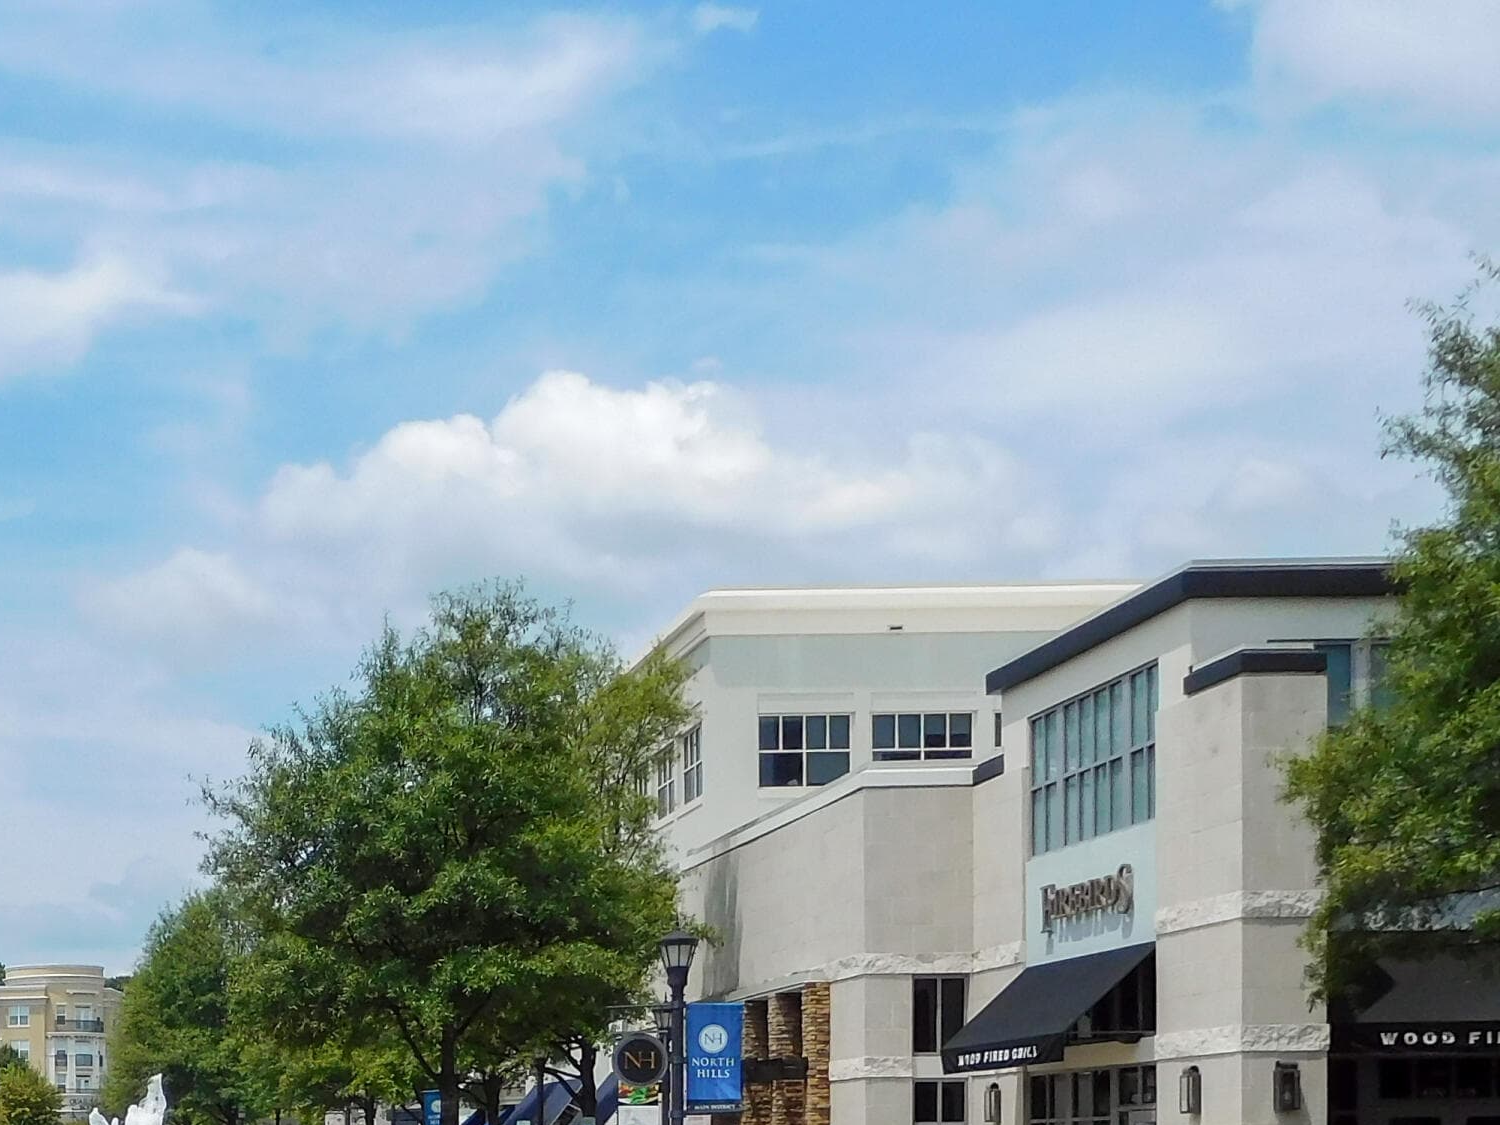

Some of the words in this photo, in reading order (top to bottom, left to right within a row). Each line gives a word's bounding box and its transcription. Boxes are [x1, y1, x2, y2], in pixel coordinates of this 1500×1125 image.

[1040, 863, 1133, 934] FIREBIRDS
[1380, 1031, 1456, 1046] WOOD
[1468, 1030, 1500, 1045] FI
[624, 1051, 655, 1069] NH
[691, 1057, 735, 1067] NORTH
[983, 1048, 1010, 1064] FIRED
[697, 1069, 731, 1079] HILLS
